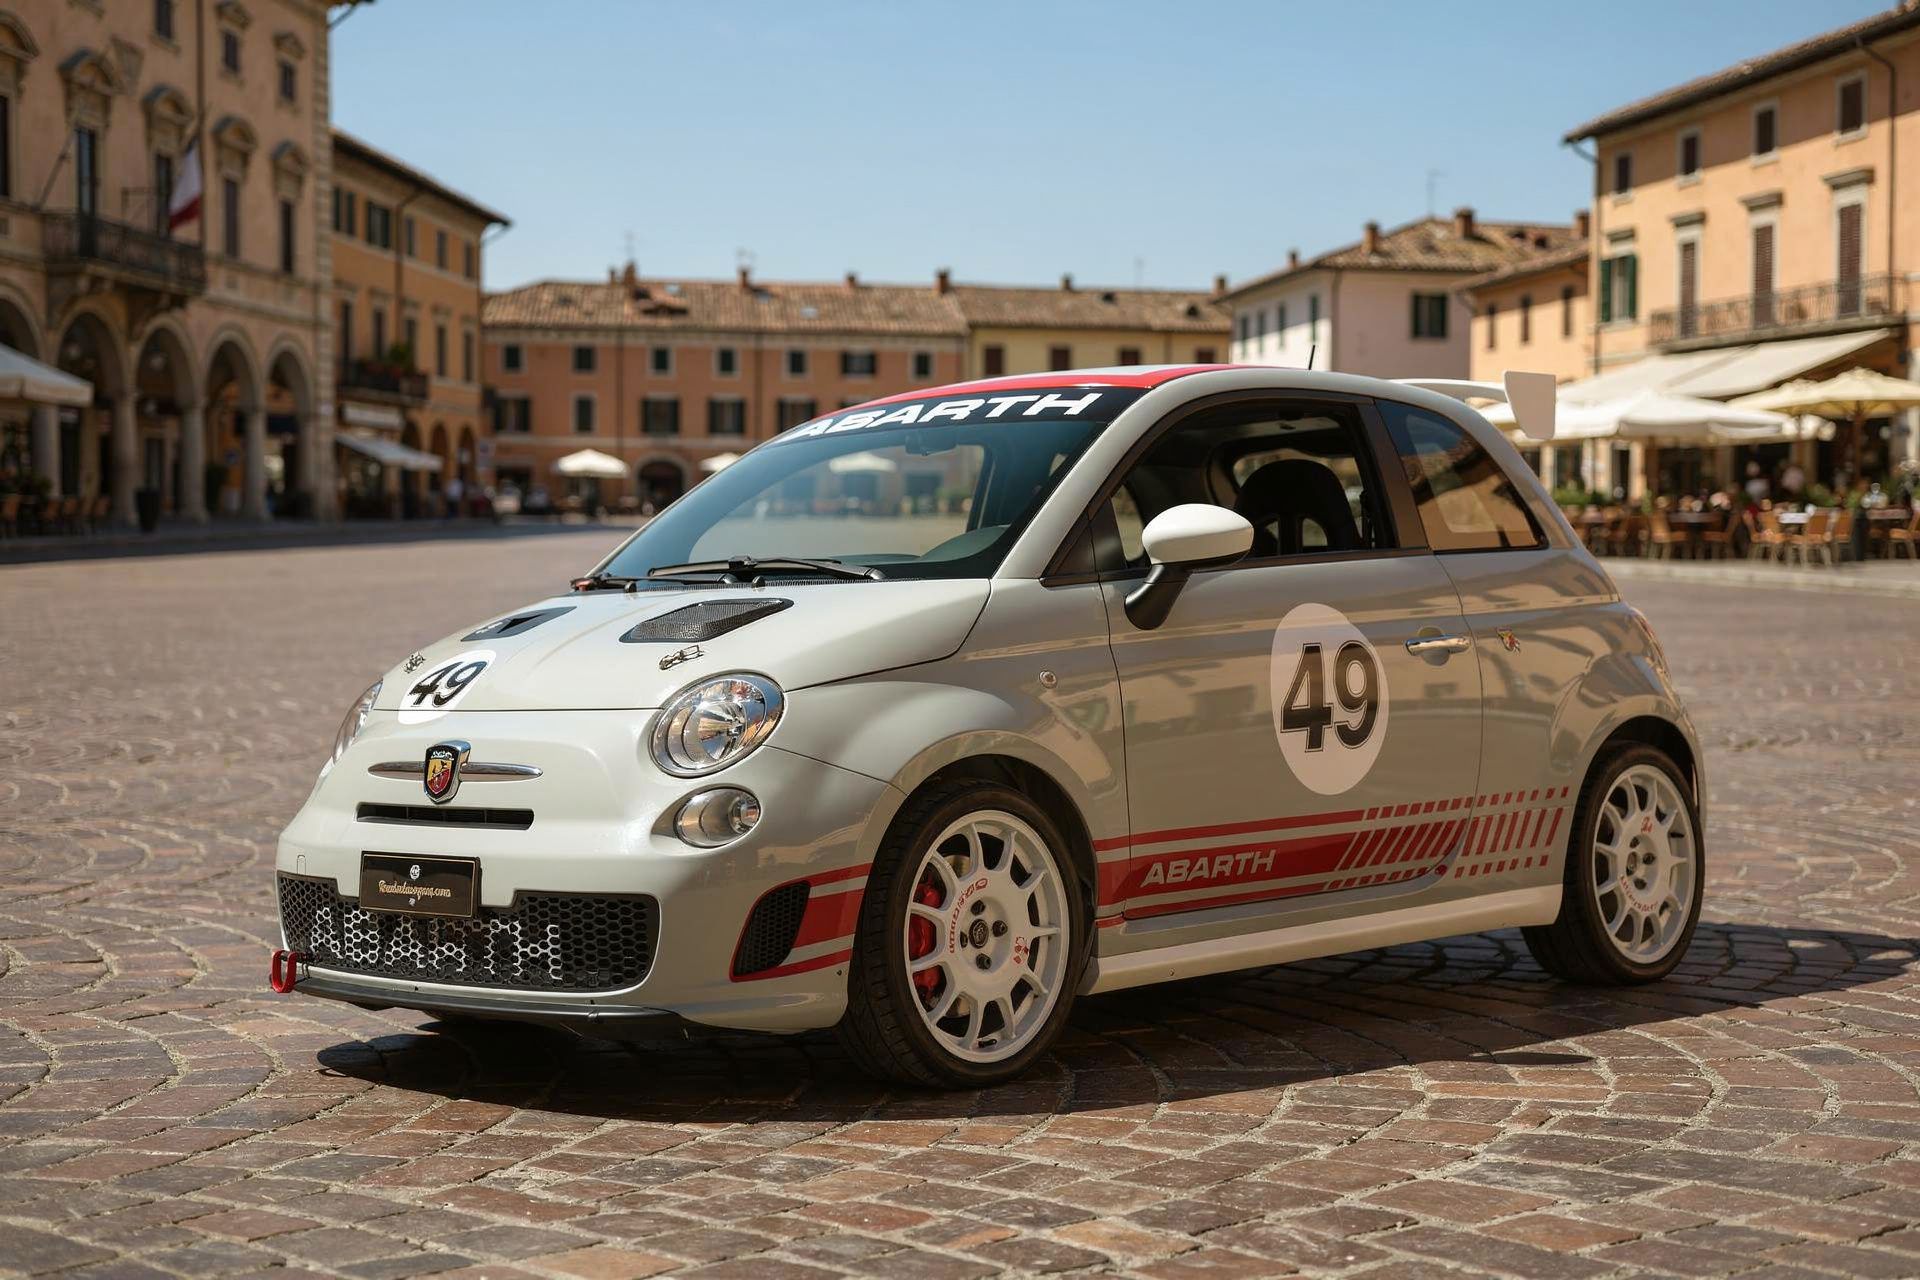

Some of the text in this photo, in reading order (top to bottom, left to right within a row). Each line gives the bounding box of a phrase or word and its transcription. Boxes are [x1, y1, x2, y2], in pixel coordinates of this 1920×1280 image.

[774, 393, 1103, 442] ABARTH
[408, 660, 489, 707] 49
[1280, 640, 1380, 753] 49
[1139, 849, 1276, 888] ABARTH
